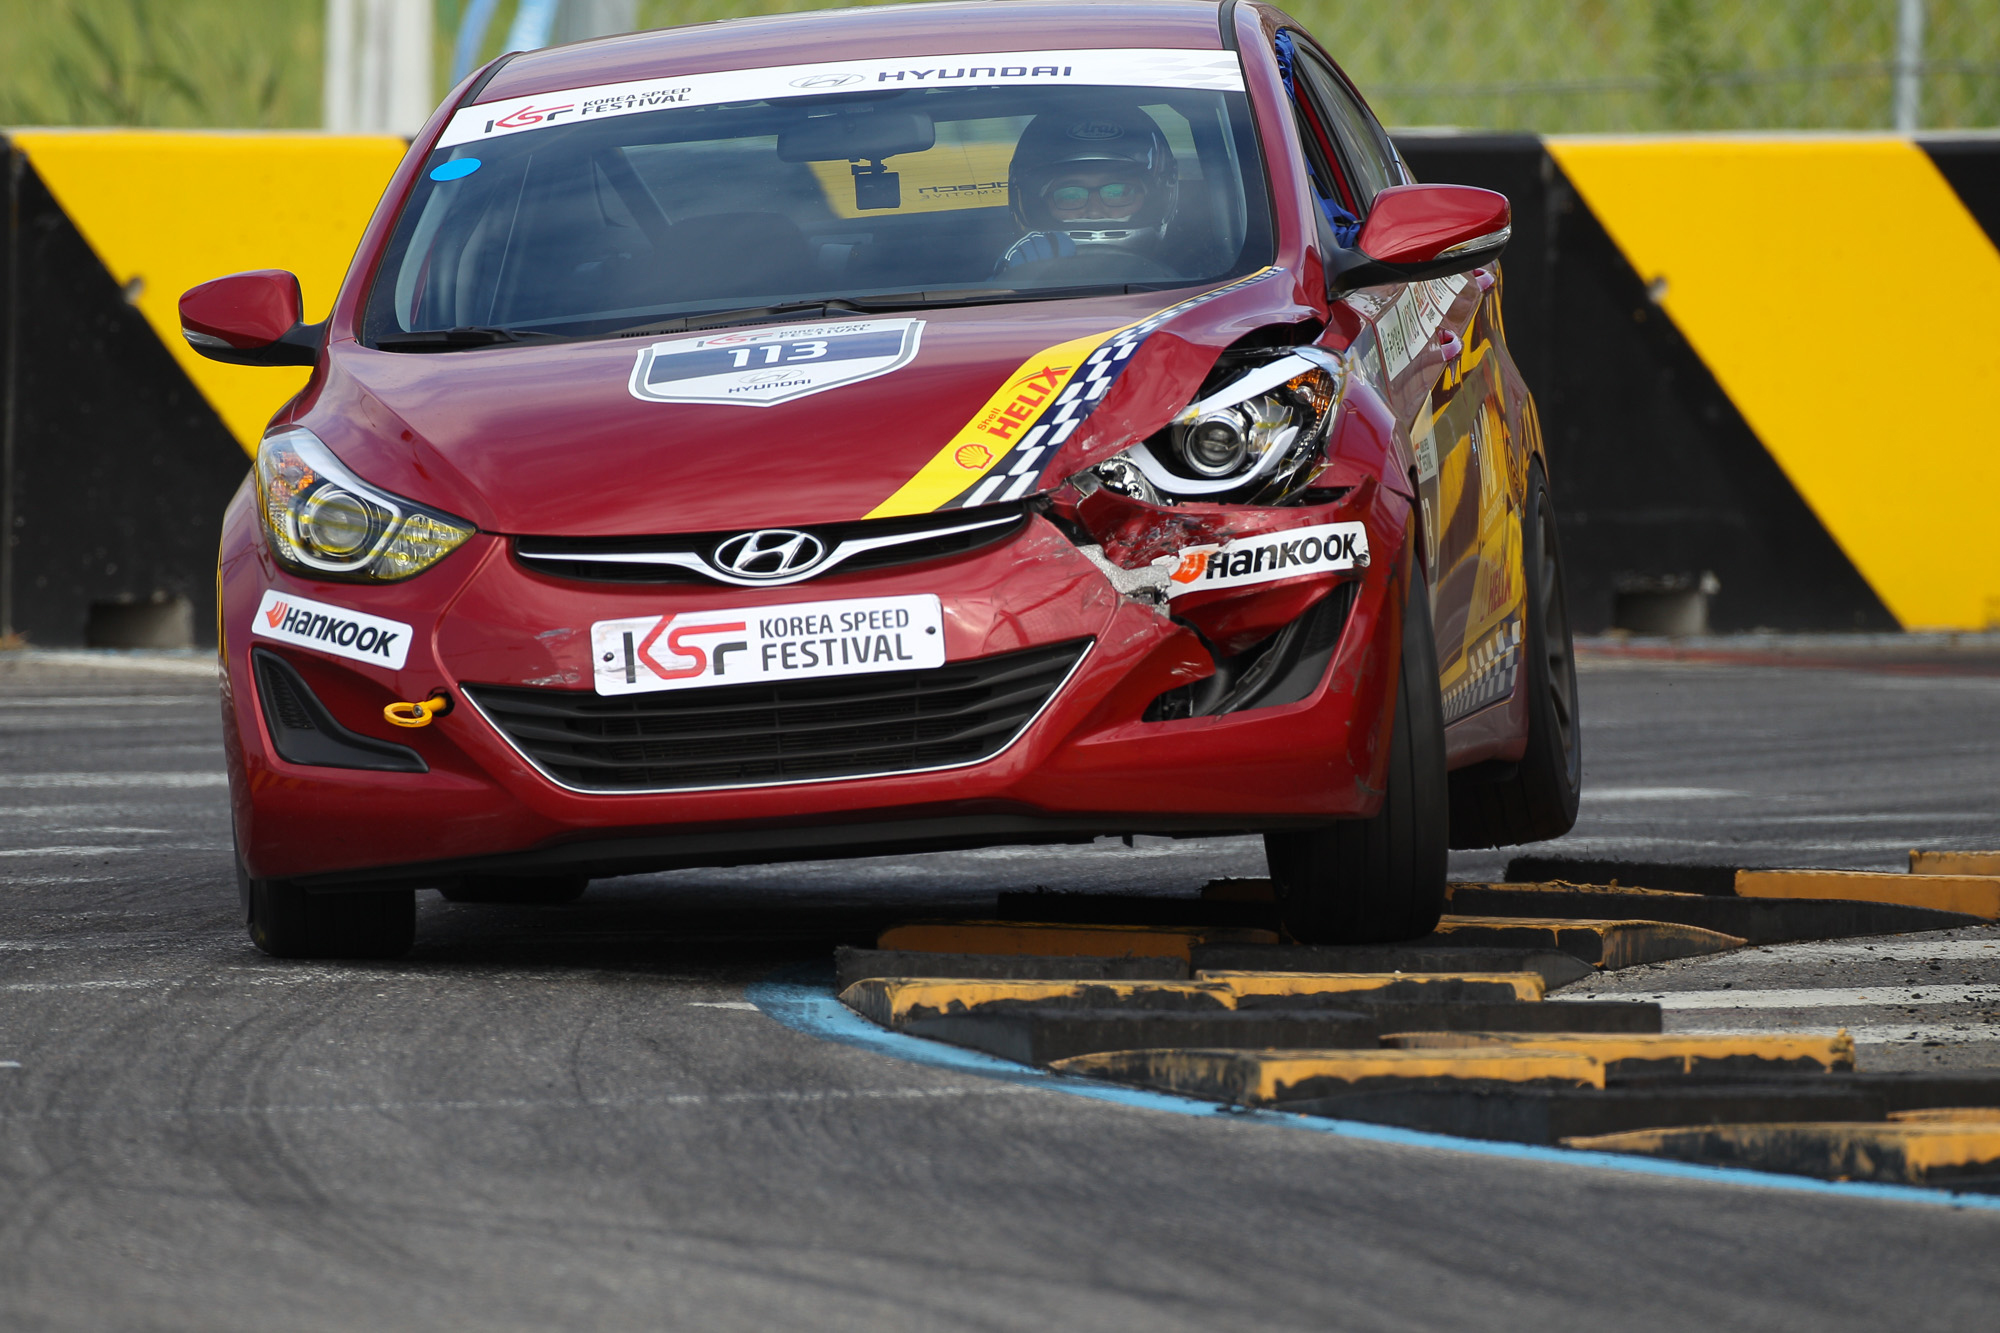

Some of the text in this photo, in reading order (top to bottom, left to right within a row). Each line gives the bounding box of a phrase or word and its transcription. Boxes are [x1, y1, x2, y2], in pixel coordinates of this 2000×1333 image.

[877, 66, 1072, 82] HYUNDAI
[581, 94, 690, 115] FESTIVAL
[583, 87, 692, 107] KOREA SPEED
[779, 326, 871, 339] FESTIVAL
[728, 340, 829, 368] 113
[728, 379, 812, 393] HYUNDAI
[987, 366, 1070, 440] HELIX
[977, 407, 1001, 431] Shell
[759, 609, 909, 639] KOREA SPEED
[623, 613, 748, 684] KSF
[760, 633, 914, 672] FESTIVAL
